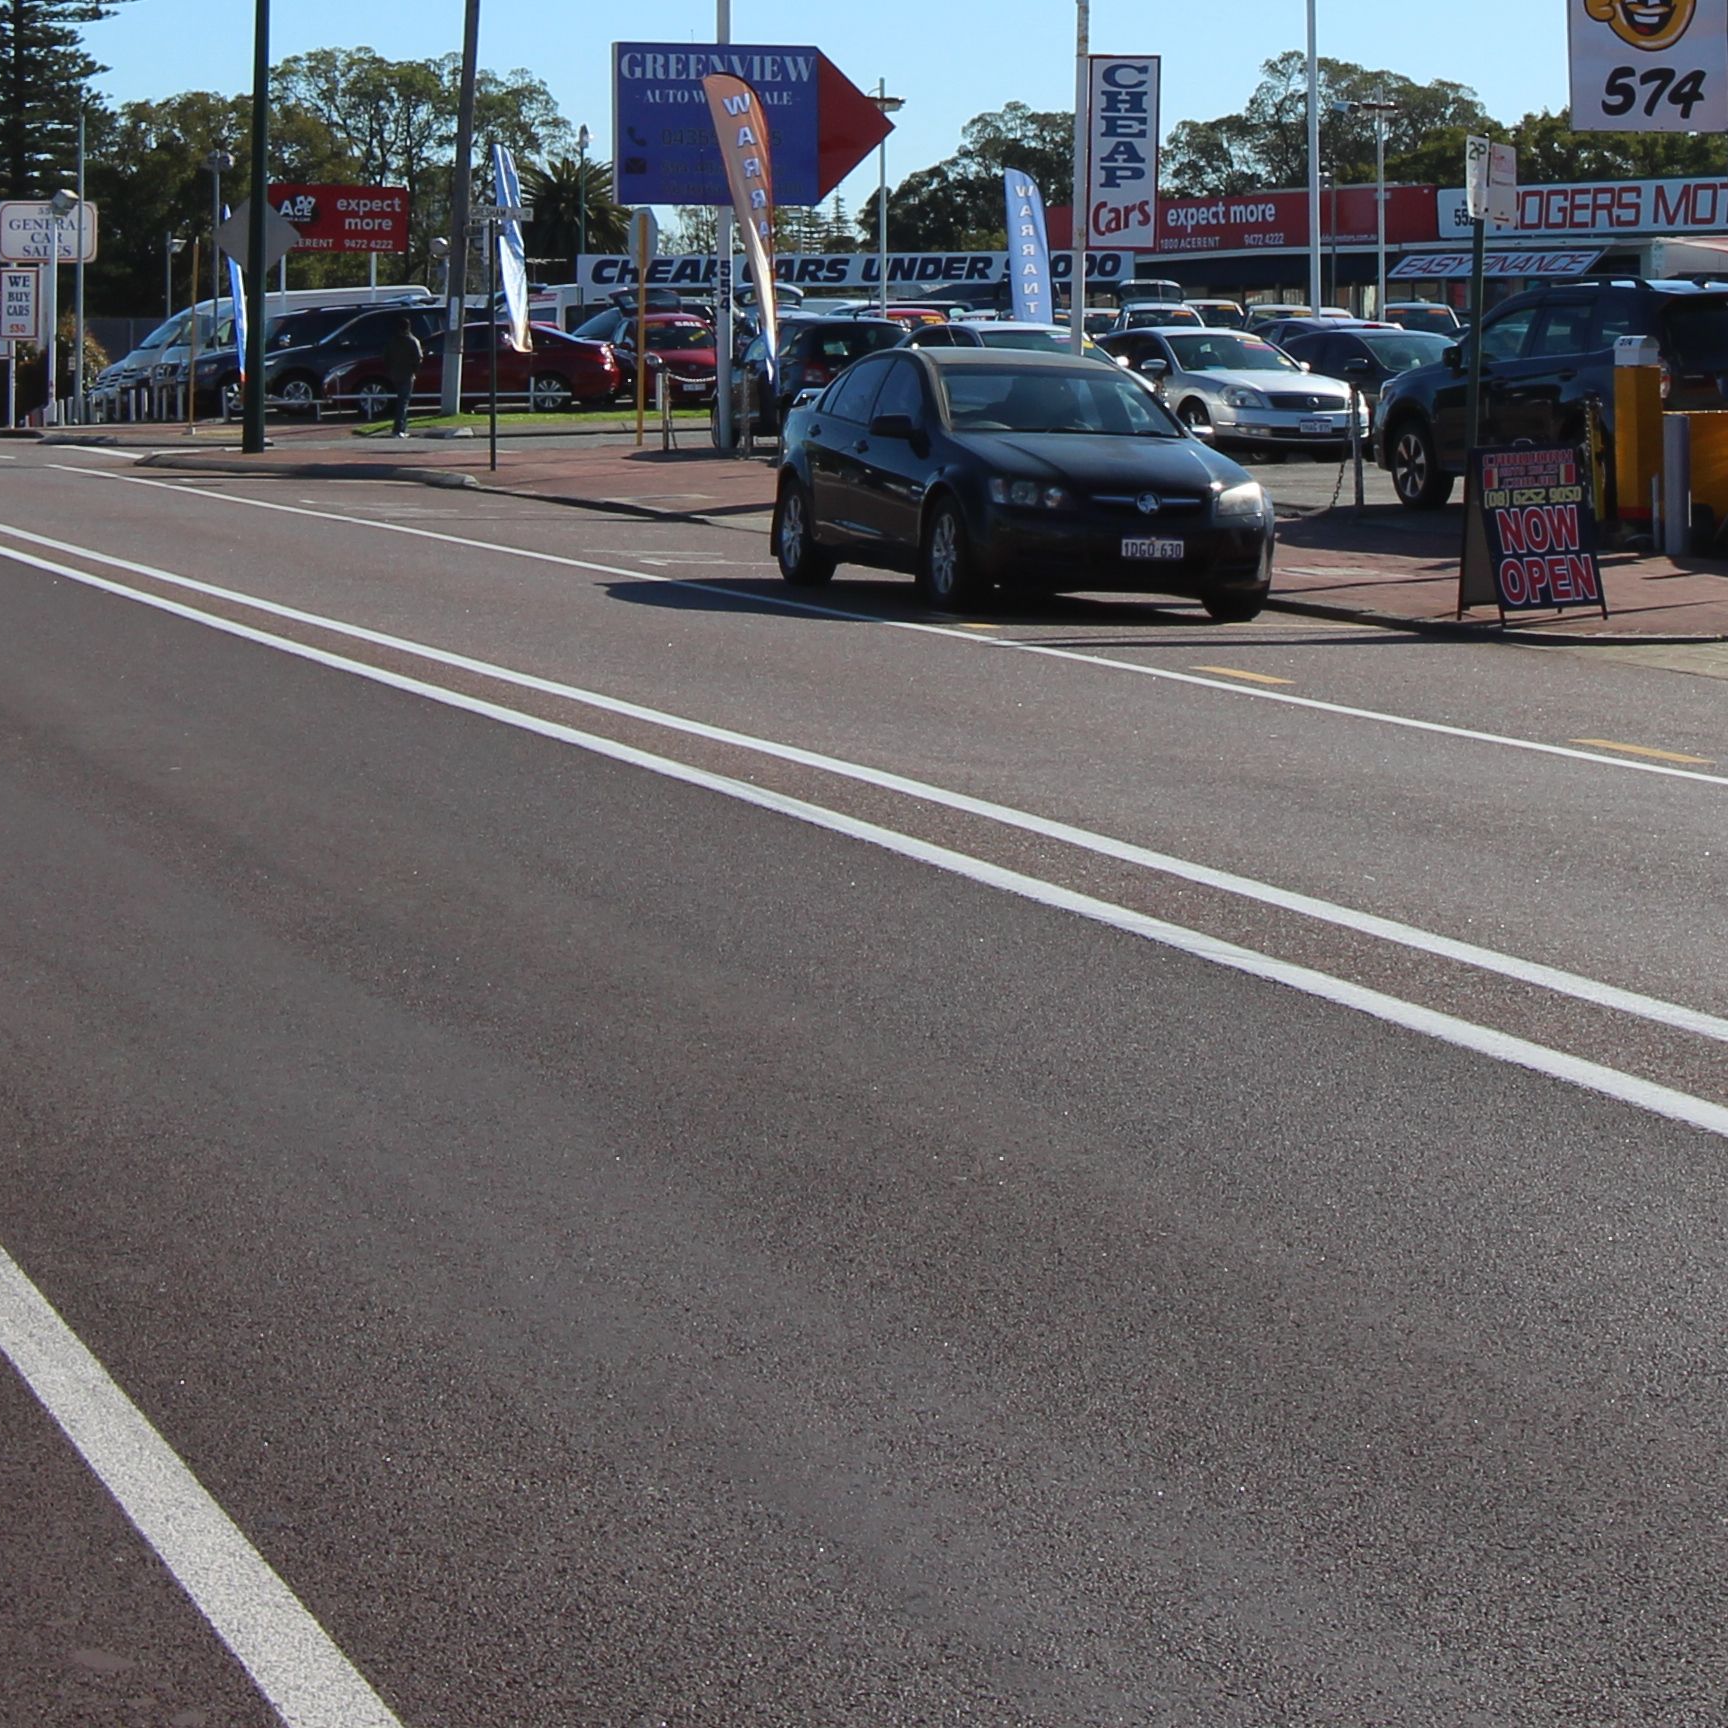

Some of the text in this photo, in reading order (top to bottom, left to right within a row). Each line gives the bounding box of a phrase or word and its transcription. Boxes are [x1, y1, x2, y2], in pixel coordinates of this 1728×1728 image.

[621, 52, 816, 82] GREENVIEW
[643, 89, 689, 104] AUTO
[1600, 67, 1709, 118] 574
[1099, 63, 1149, 189] CHEAP
[279, 200, 312, 216] ACE
[336, 197, 402, 215] expect
[1167, 200, 1276, 233] expect more
[1496, 185, 1642, 230] OGERS
[344, 218, 393, 230] more
[1092, 200, 1152, 237] Cars
[370, 239, 393, 249] 4222
[1160, 233, 1284, 249] 1800 ACERENT 9472 4222
[861, 253, 993, 281] UNDER
[1395, 257, 1473, 275] EASY
[8, 275, 30, 287] WE
[720, 260, 731, 313] 554
[8, 292, 31, 302] BUY
[7, 305, 30, 316] CARS
[1484, 488, 1510, 509] (08)
[1495, 504, 1580, 555] NOW
[1499, 553, 1598, 605] OPEN
